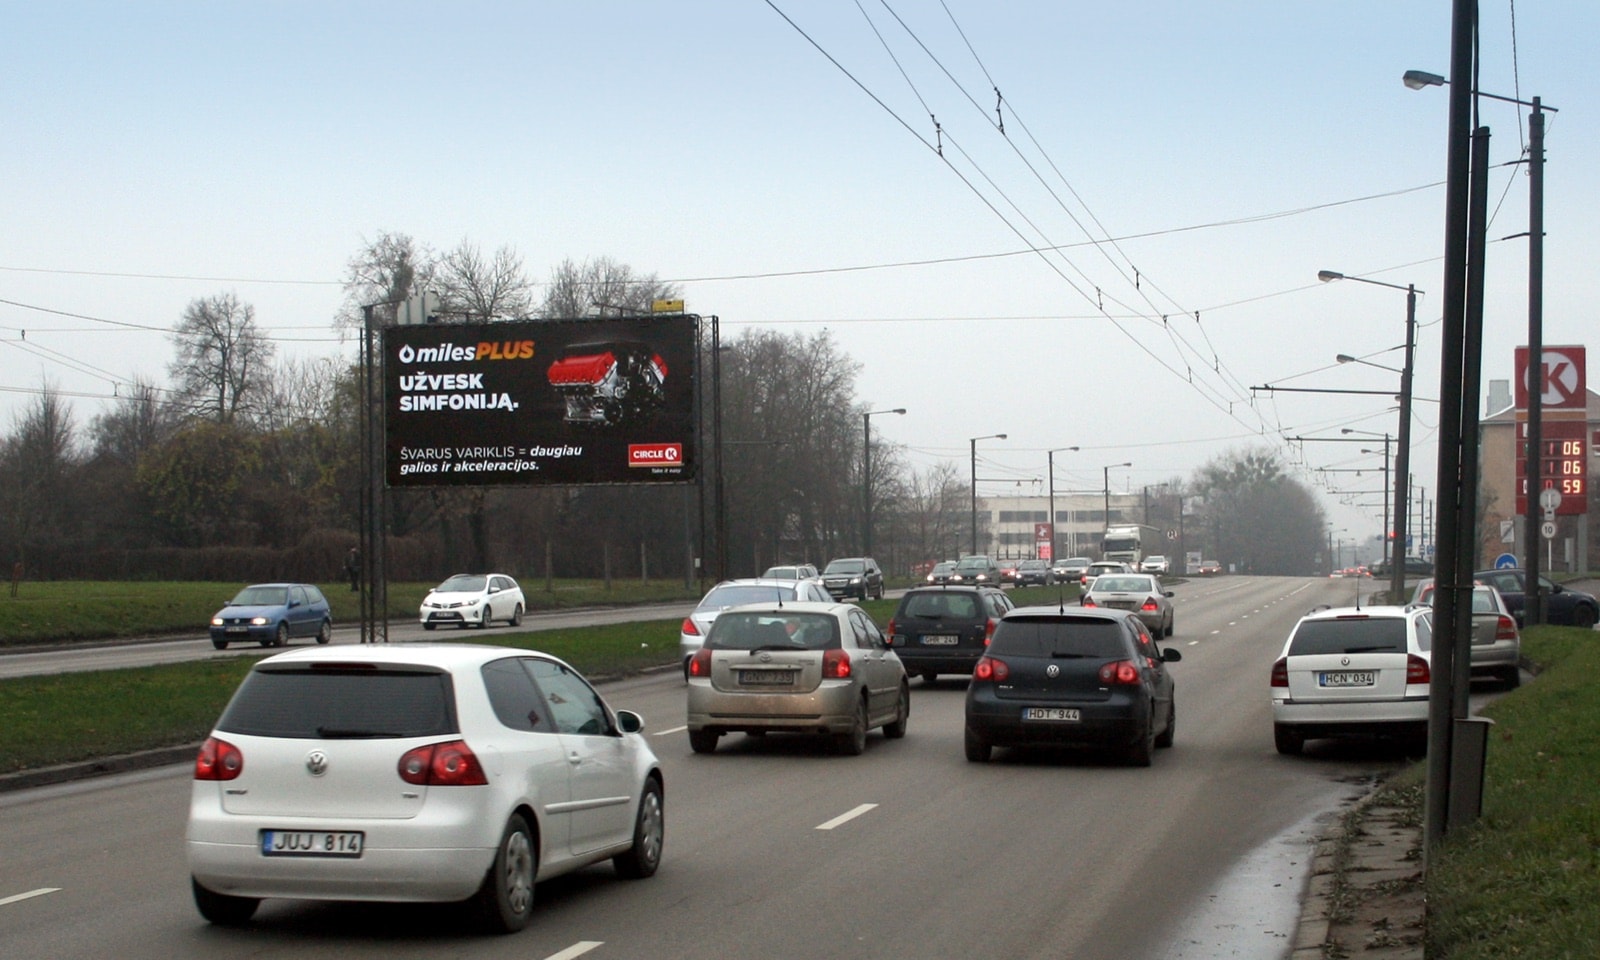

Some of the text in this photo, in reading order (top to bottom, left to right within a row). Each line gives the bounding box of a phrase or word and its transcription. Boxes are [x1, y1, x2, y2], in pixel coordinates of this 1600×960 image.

[399, 371, 484, 391] UŽVESK
[399, 392, 519, 412] SIMFONIJĄ.
[400, 446, 452, 460] ŠVARUS
[455, 446, 515, 459] VARIKLIS
[530, 444, 583, 458] daugiau
[633, 450, 664, 459] CIRCLE
[400, 459, 539, 475] galios ir akceleracijos.
[1544, 525, 1553, 534] 10
[1326, 673, 1372, 683] HCN 034
[1029, 709, 1078, 719] HDT 944
[275, 834, 357, 851] JUJ 814
